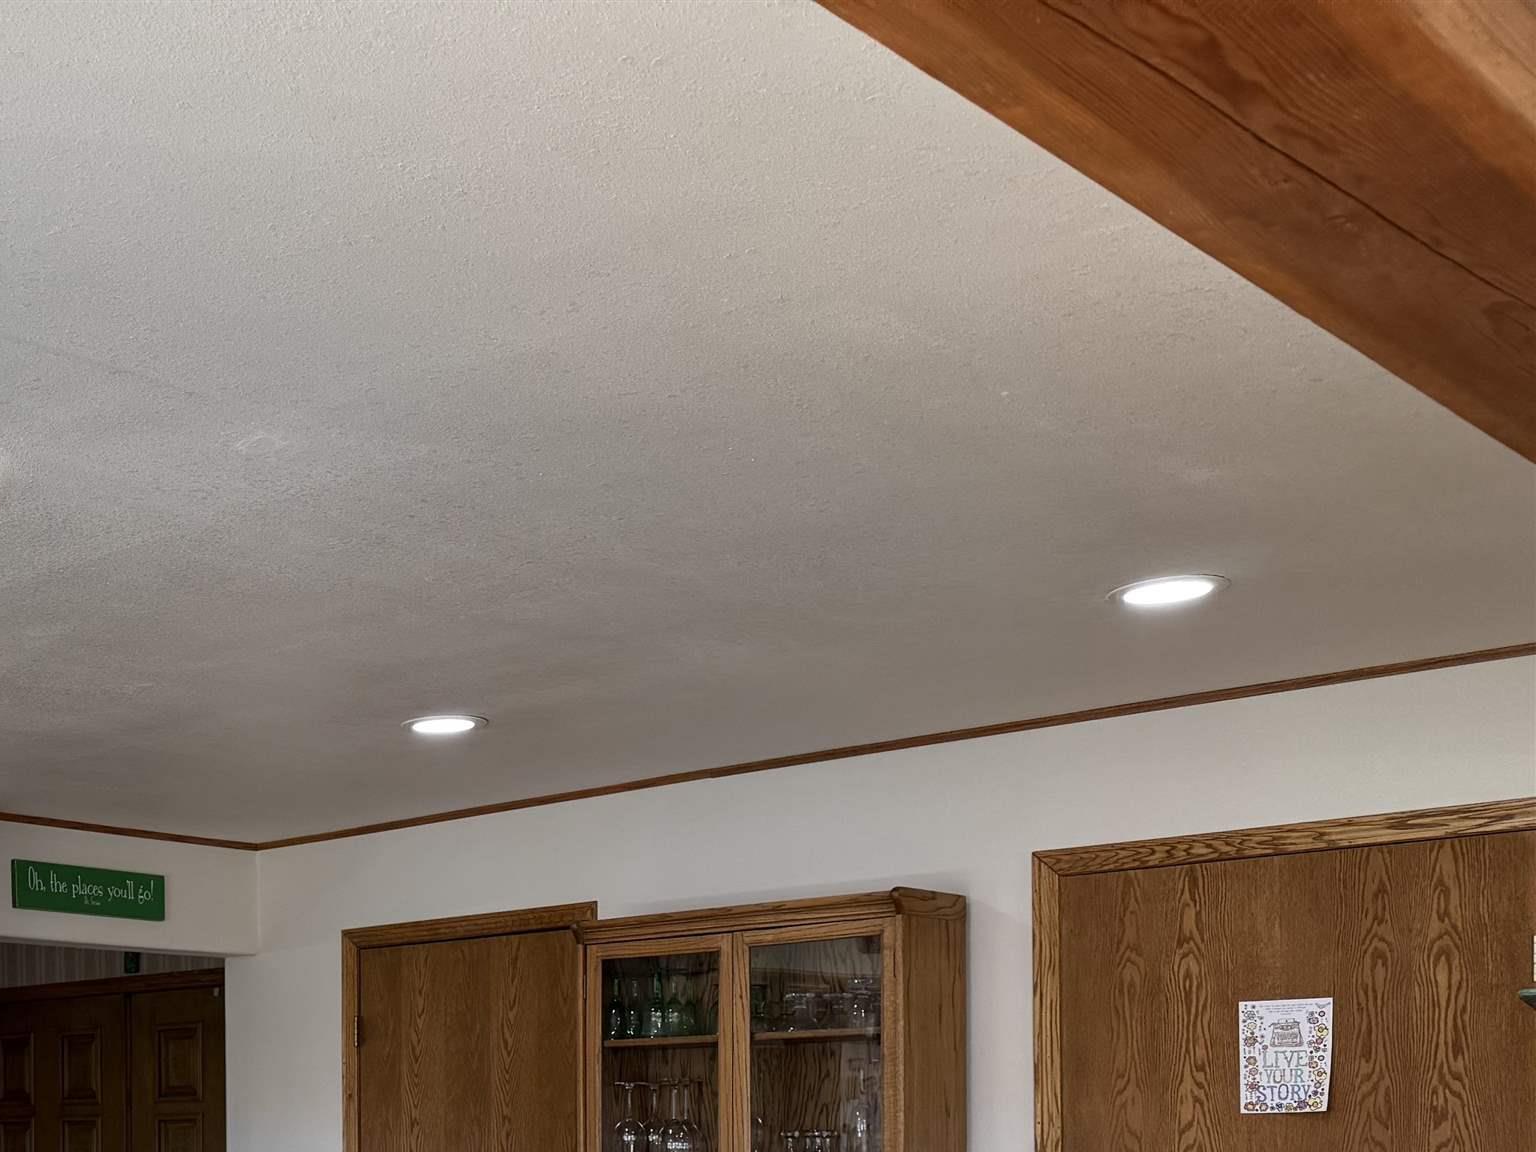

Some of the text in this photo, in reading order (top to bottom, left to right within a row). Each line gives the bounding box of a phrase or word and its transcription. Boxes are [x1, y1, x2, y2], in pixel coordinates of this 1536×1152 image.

[28, 866, 46, 892] Oh,
[50, 870, 68, 894] the
[72, 875, 104, 898] places
[138, 880, 154, 904] go!
[1262, 1050, 1308, 1068] LIVE
[1263, 1068, 1306, 1084] YOUR
[1255, 1083, 1312, 1103] STORY
